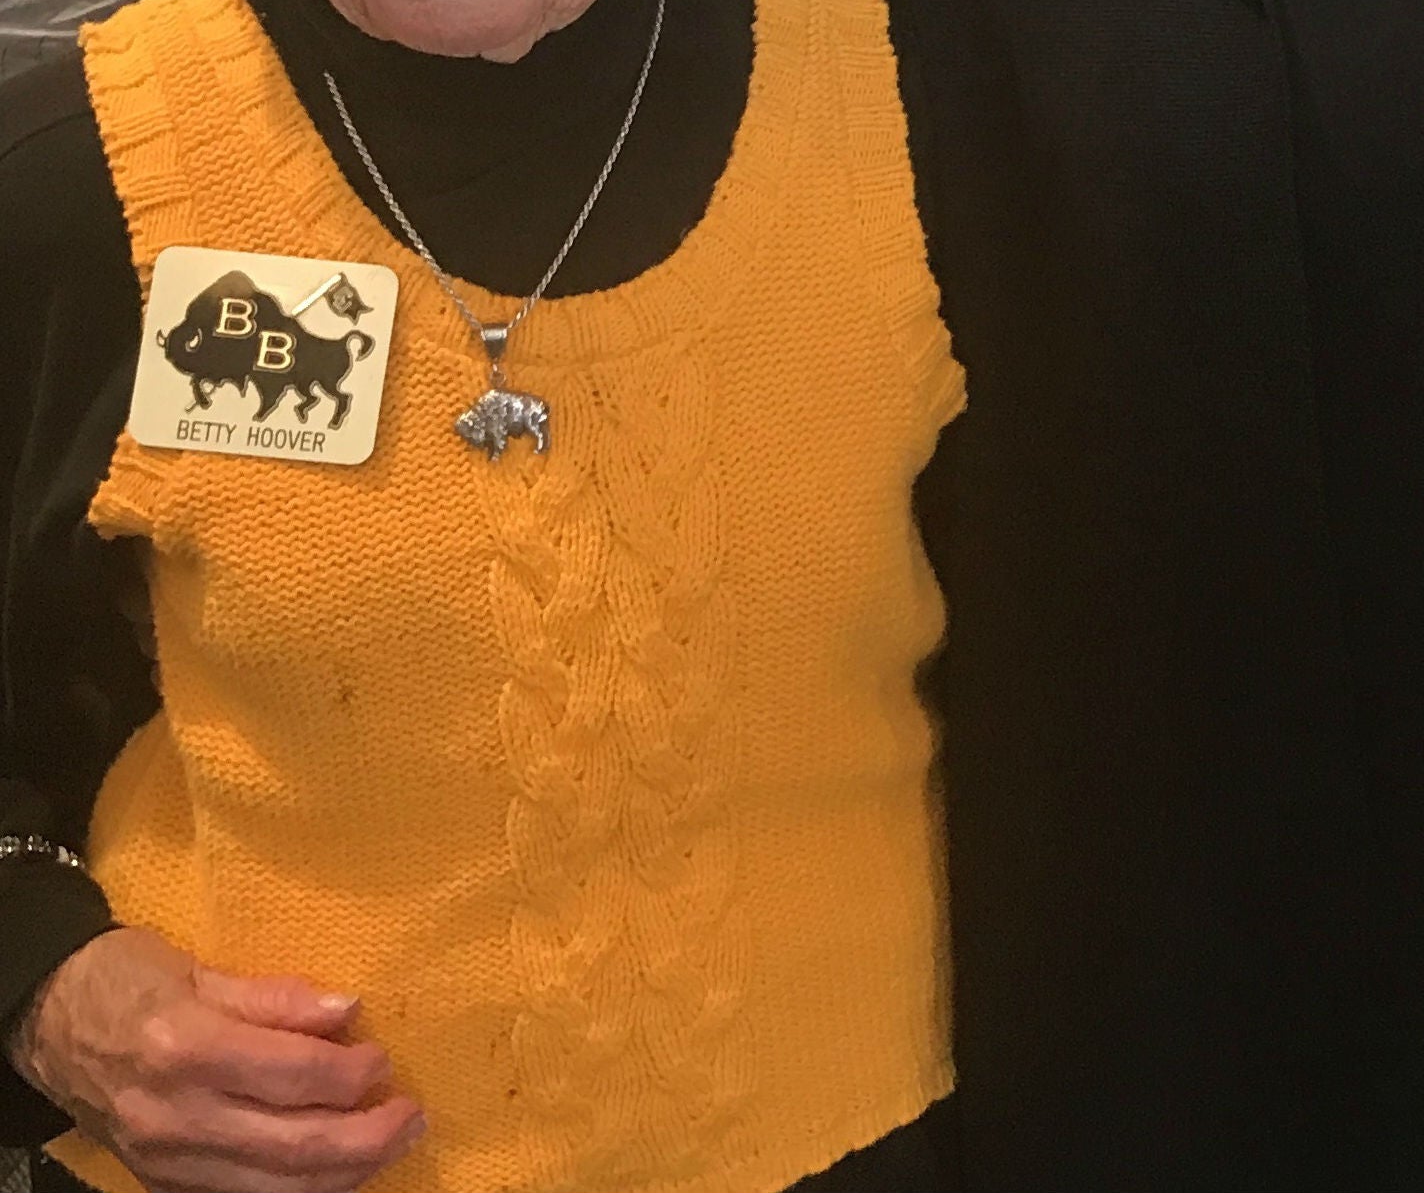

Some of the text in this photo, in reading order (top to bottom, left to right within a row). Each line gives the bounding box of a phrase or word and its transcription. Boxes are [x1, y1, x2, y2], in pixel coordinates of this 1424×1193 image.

[213, 297, 257, 339] B
[254, 330, 296, 373] B
[176, 419, 326, 453] BETTY HOOVER
